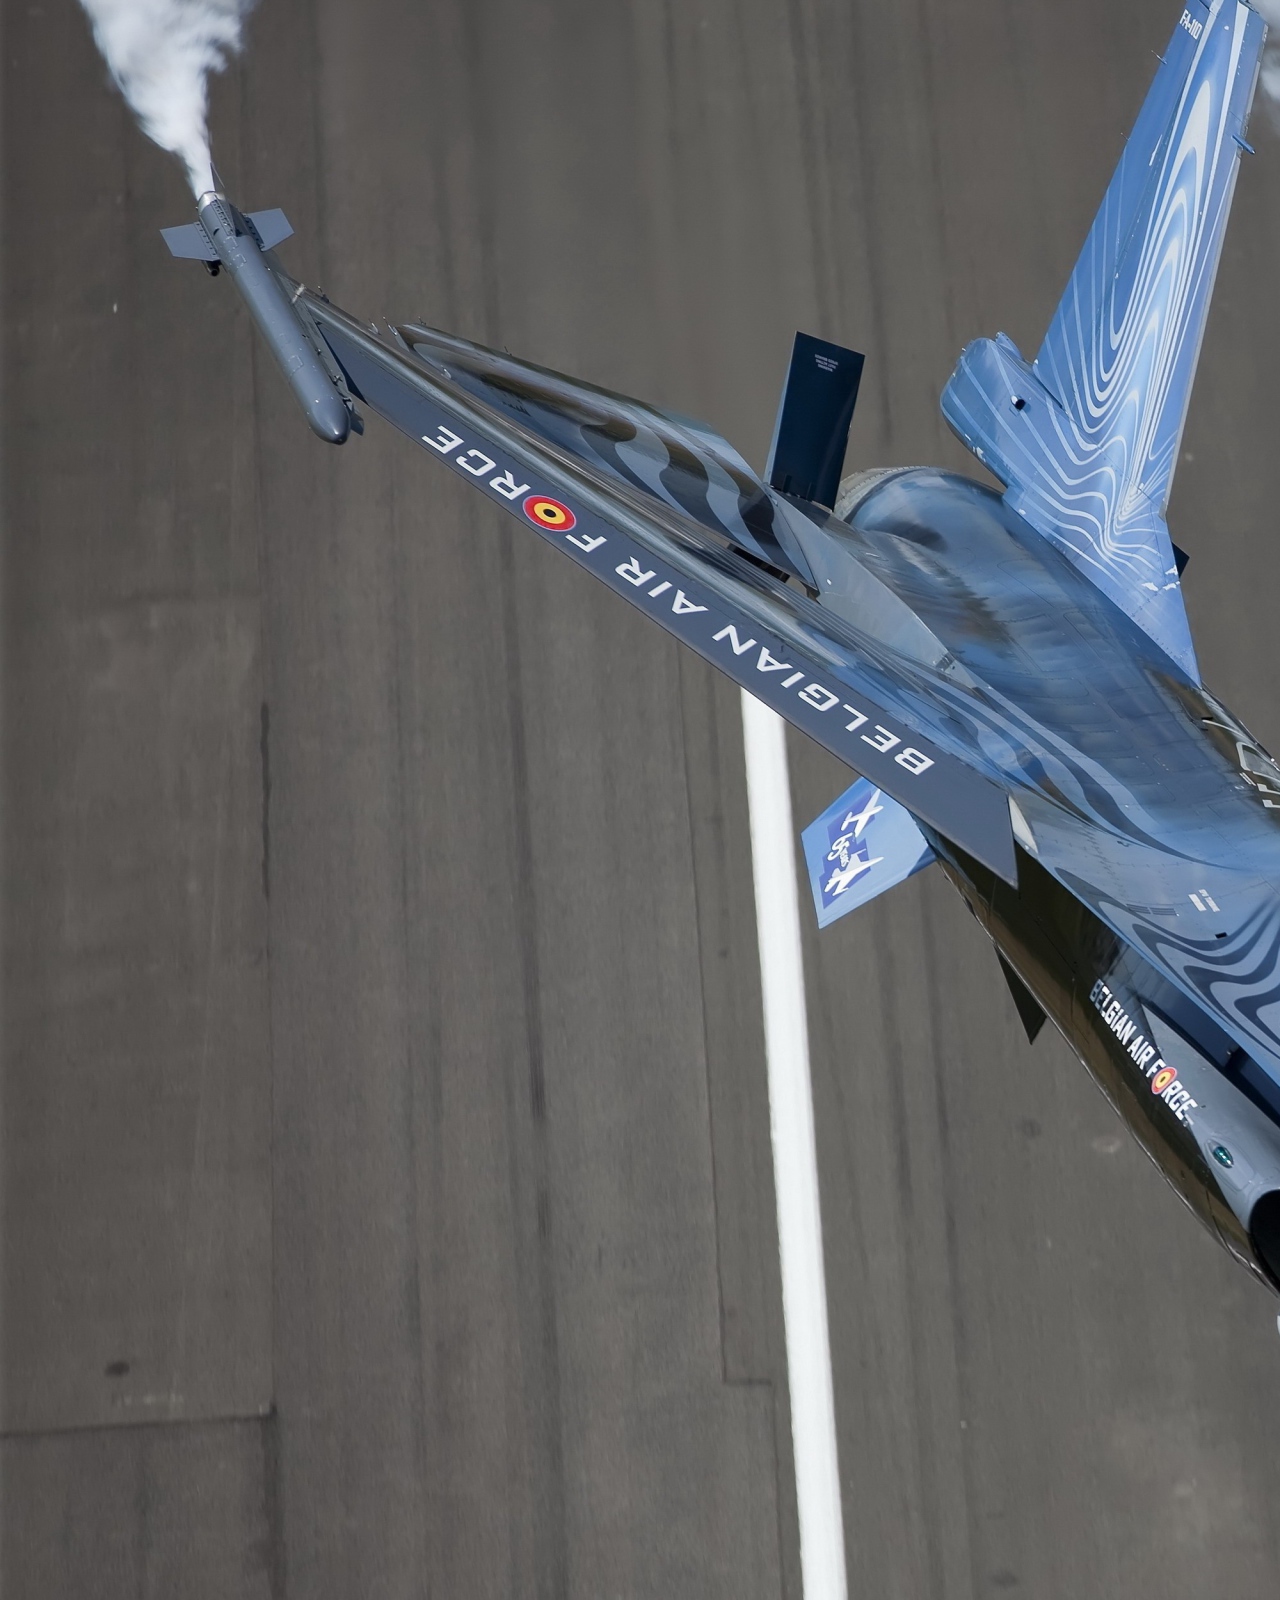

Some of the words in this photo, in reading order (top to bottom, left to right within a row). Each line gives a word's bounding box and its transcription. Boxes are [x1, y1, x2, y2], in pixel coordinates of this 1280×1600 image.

[615, 556, 708, 615] AIR
[712, 624, 935, 776] BELGIAN
[1089, 979, 1137, 1045] BELGIAN
[1126, 1035, 1156, 1071] AIR
